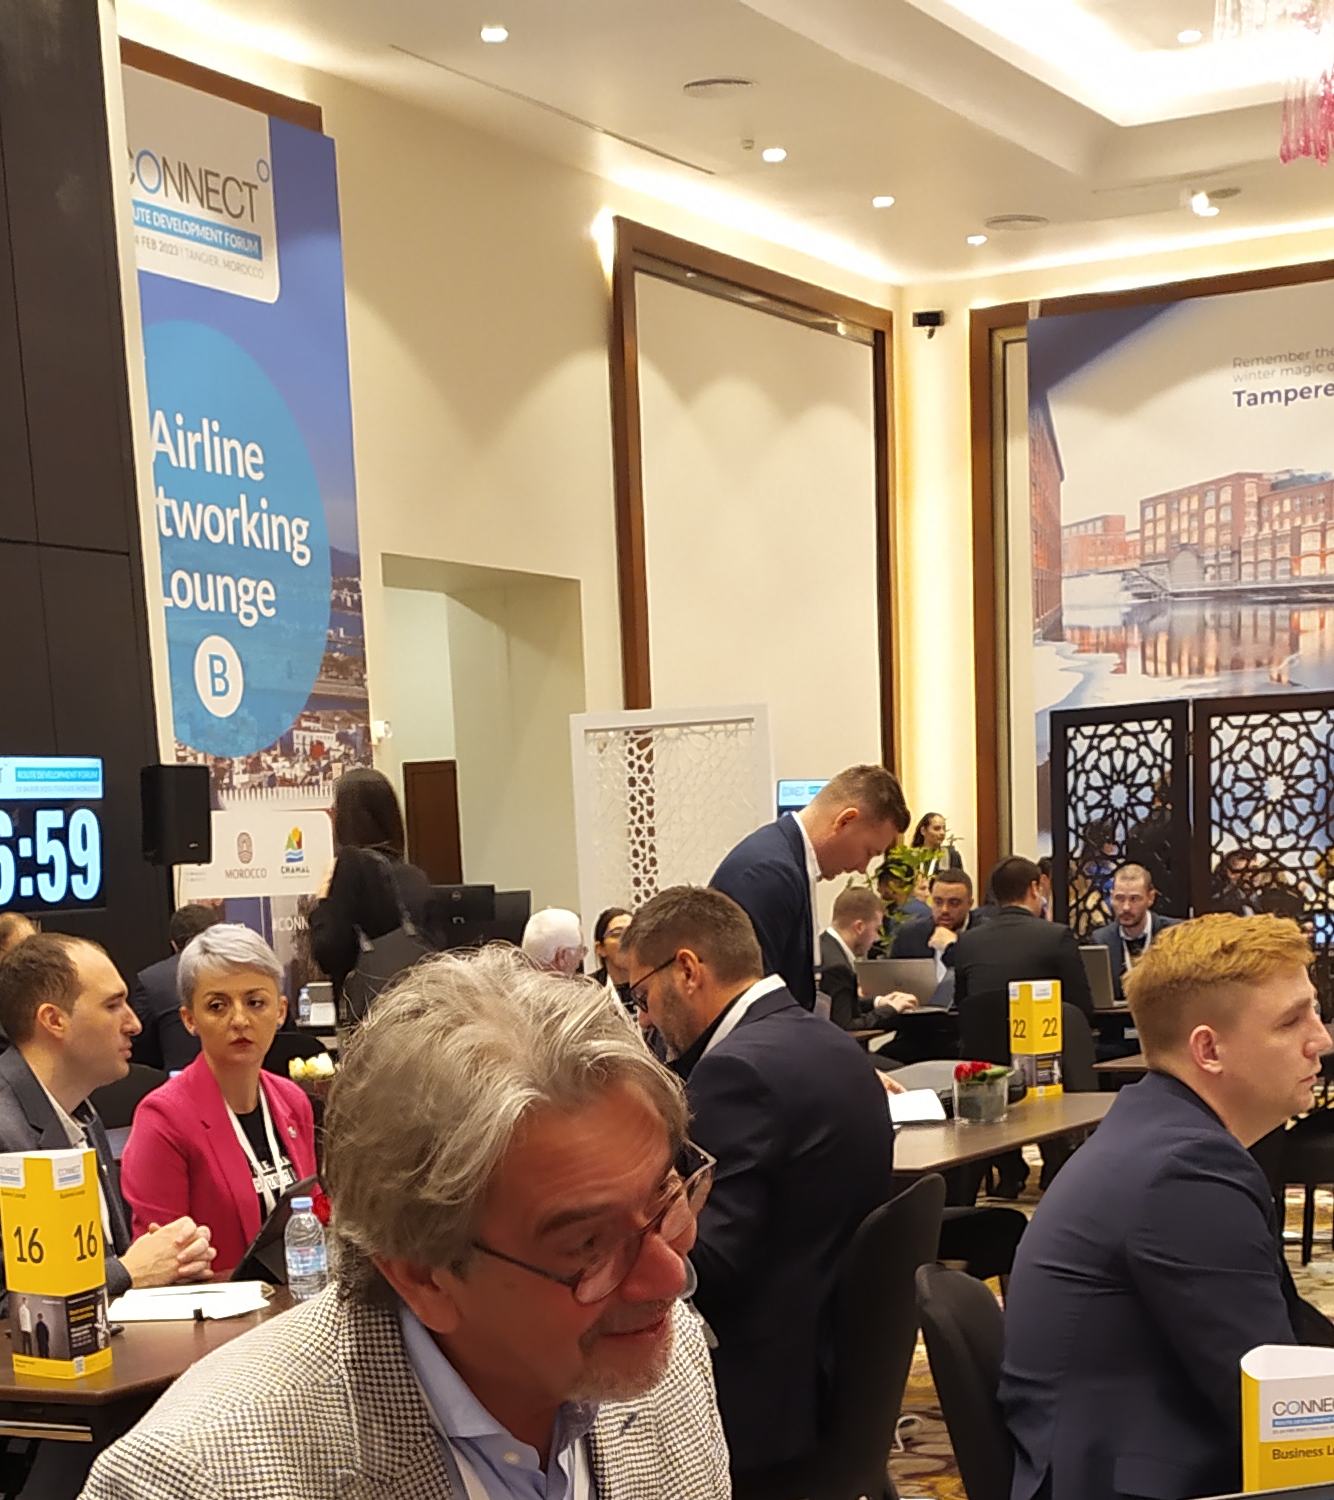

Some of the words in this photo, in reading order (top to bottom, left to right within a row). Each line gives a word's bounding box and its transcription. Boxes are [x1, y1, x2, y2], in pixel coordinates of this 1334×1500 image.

[128, 148, 259, 223] ONNECT
[153, 211, 223, 245] DEVELOPMENT
[224, 232, 260, 253] FORUM
[142, 236, 157, 249] FEB
[222, 258, 264, 280] MOROCCO
[1232, 350, 1311, 369] Remember
[1232, 369, 1276, 383] winter
[1280, 362, 1324, 377] magic
[152, 409, 264, 482] Airline
[156, 485, 312, 567] tworking
[208, 654, 230, 698] B
[225, 867, 267, 880] MOROCCO
[1013, 1019, 1026, 1038] 22
[1042, 1017, 1058, 1037] 22
[13, 1226, 44, 1264] 16
[73, 1220, 98, 1261] 16
[1272, 1447, 1324, 1460] Business
